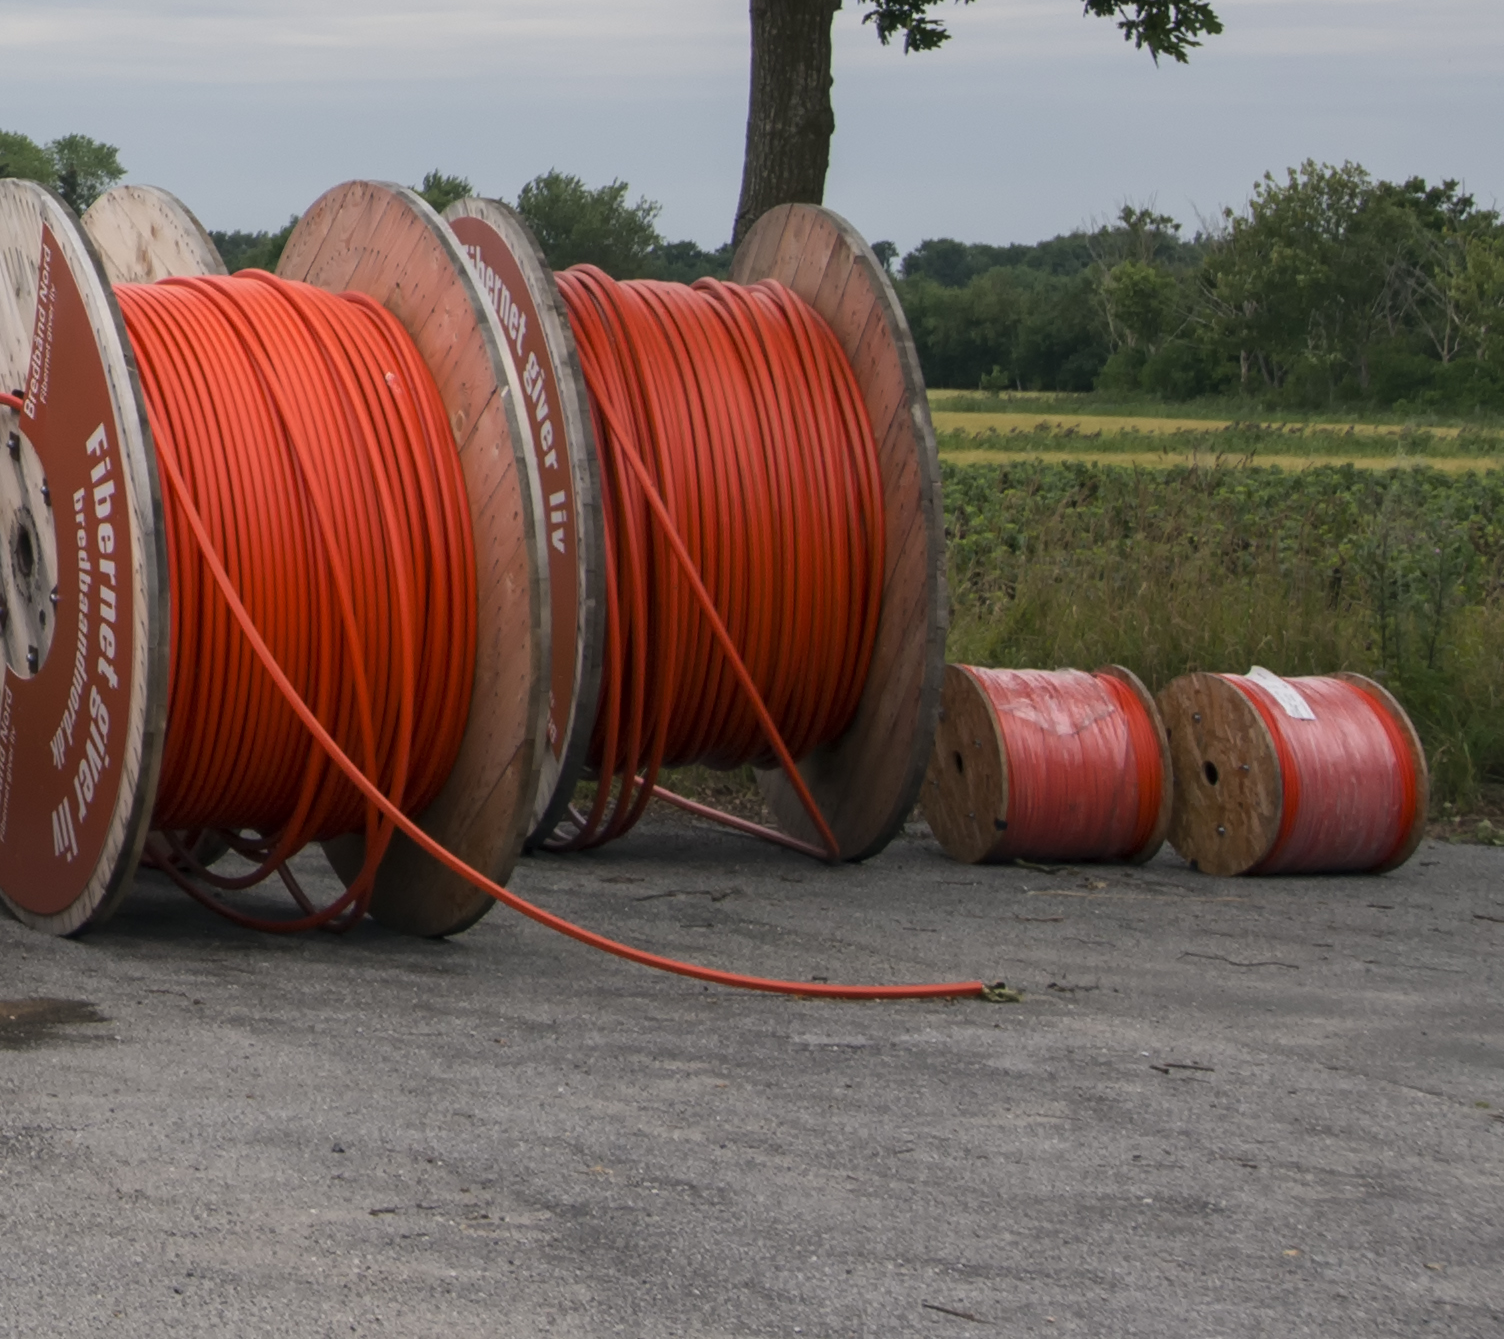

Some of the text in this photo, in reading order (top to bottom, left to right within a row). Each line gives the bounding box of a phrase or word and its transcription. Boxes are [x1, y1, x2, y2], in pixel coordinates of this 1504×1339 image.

[24, 243, 52, 420] Bredbånd Nord
[40, 343, 52, 404] Fibernet
[46, 304, 55, 342] giver
[522, 352, 558, 470] giver
[548, 489, 567, 554] liv
[0, 685, 13, 744] Nord
[50, 487, 93, 771] bredbaandnord.dk
[51, 422, 118, 862] Fibernet giver liv
